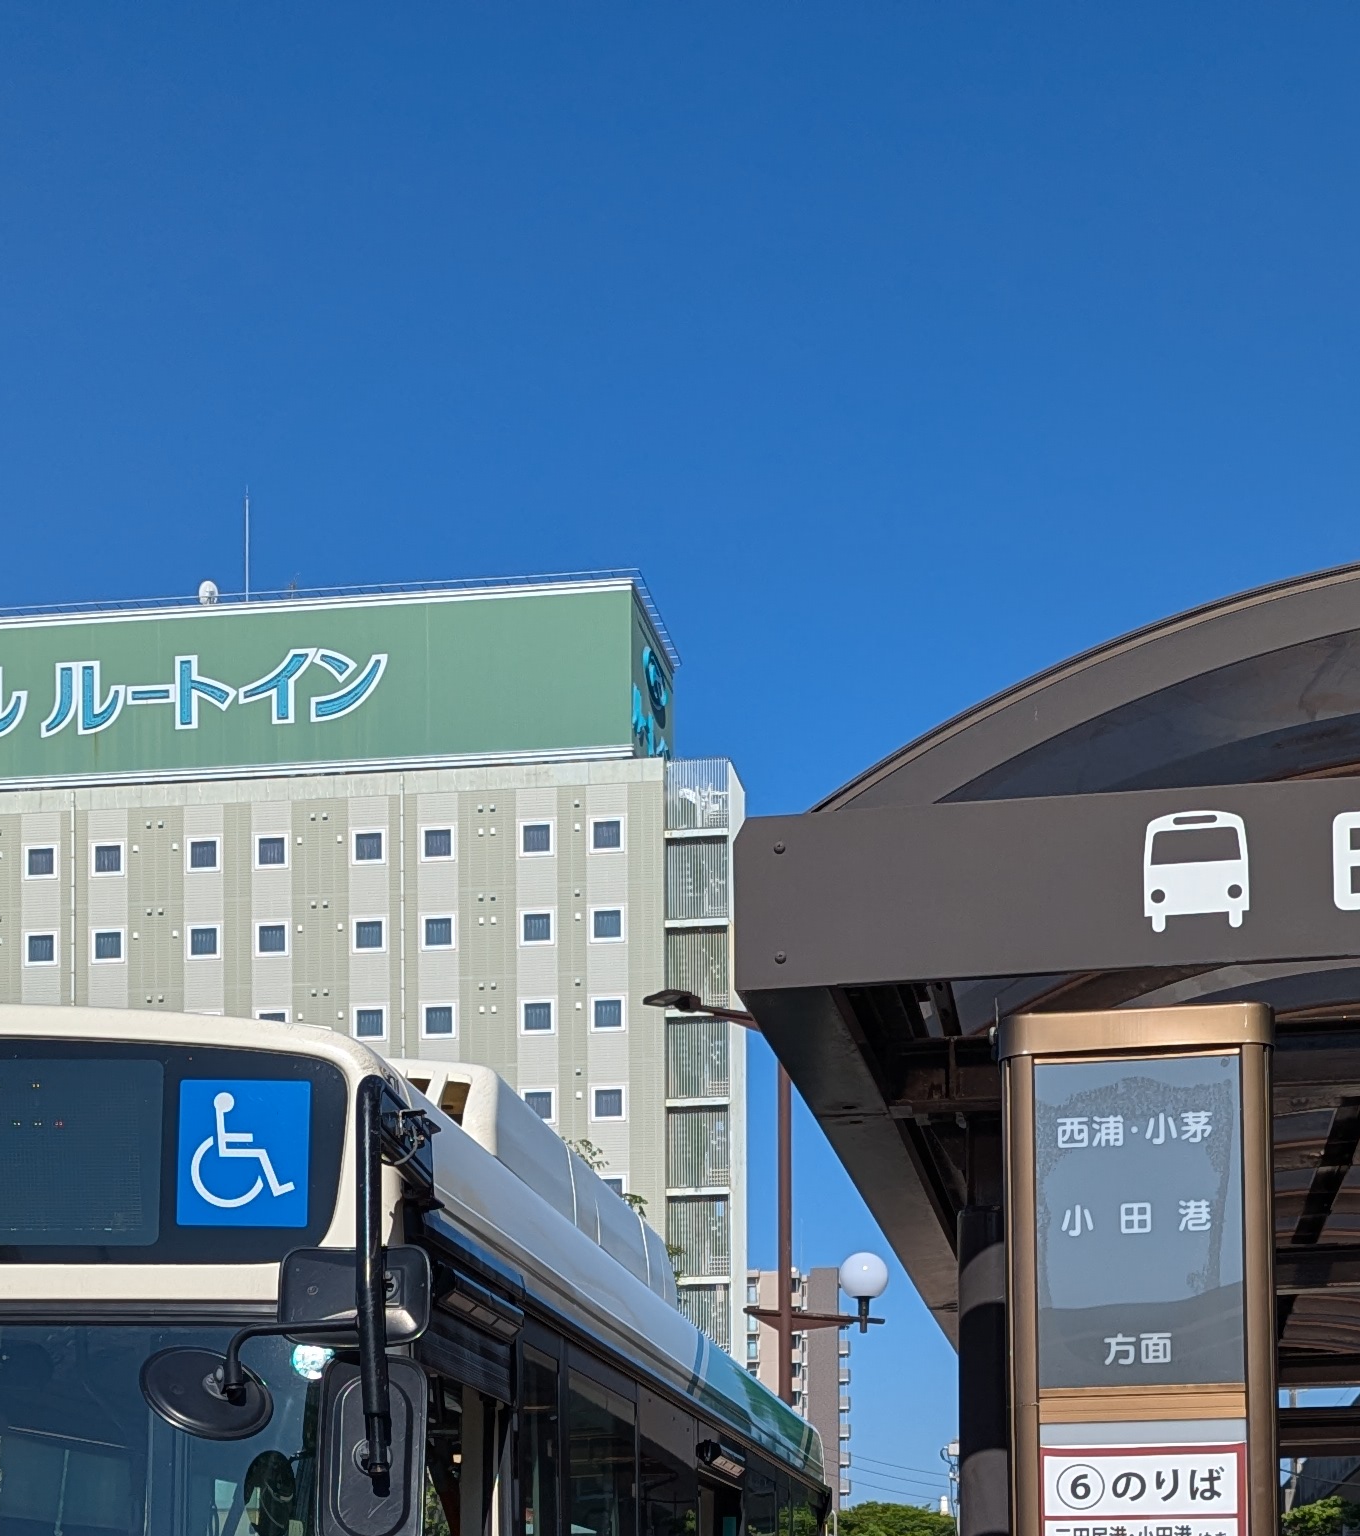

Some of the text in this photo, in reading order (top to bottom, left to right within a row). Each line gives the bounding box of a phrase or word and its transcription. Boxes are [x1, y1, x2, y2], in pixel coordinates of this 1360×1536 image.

[39, 647, 389, 738] ルートイン
[1056, 1110, 1214, 1149] 西浦・小茅
[1060, 1199, 1212, 1237] 小田港
[1103, 1332, 1173, 1366] 方面
